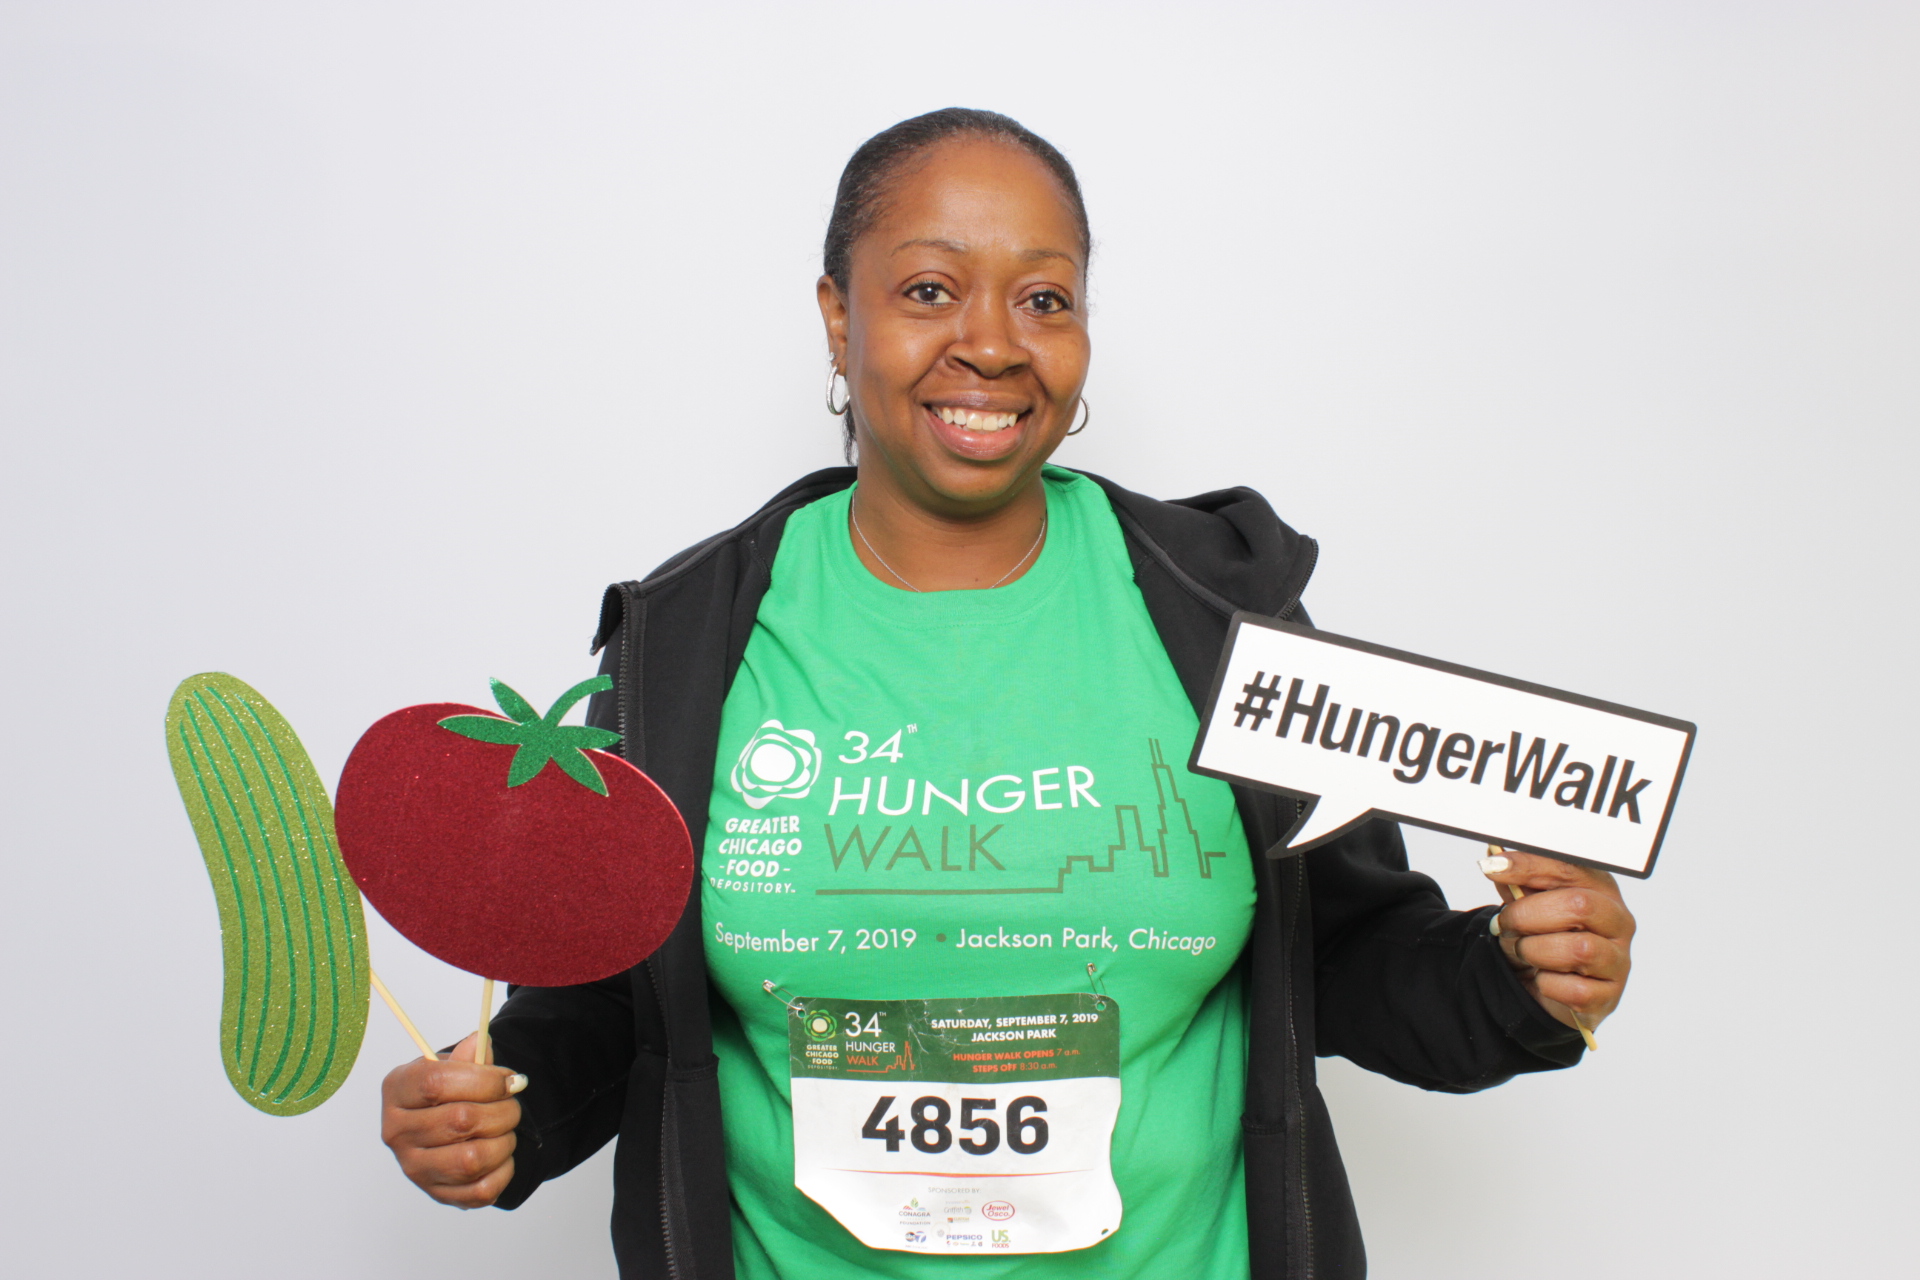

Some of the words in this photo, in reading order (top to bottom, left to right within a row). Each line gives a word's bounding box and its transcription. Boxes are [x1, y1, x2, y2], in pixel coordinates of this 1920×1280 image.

[1233, 670, 1653, 825] #HungerWalk
[828, 765, 1102, 817] HUNGER
[725, 815, 800, 834] GREATER
[718, 838, 803, 856] CHICAGO
[823, 823, 1007, 873] WALK
[715, 922, 819, 954] September
[827, 929, 847, 955] 7,
[855, 928, 917, 950] 2019
[956, 926, 1052, 949] Jackson
[1062, 926, 1119, 953] Park,
[1129, 927, 1217, 956] Chicago
[931, 1018, 993, 1030] SATURDAY,
[995, 1014, 1058, 1028] SEPTEMBER
[1059, 1013, 1070, 1026] 7,
[1072, 1013, 1099, 1024] 2019
[971, 1029, 1025, 1043] JACKSON
[1027, 1028, 1057, 1040] PARK
[805, 1051, 839, 1059] CHICAGO
[806, 1044, 838, 1052] GREATER
[845, 1041, 896, 1054] HUNGER
[953, 1051, 993, 1062] HUNGER
[994, 1051, 1022, 1061] WALK
[1023, 1049, 1055, 1060] OPENS
[1056, 1047, 1063, 1057] 7
[1064, 1047, 1081, 1057] a.m.
[846, 1055, 879, 1067] WALK
[972, 1064, 999, 1074] STEPS
[1000, 1063, 1018, 1073] OFF
[1019, 1062, 1040, 1072] 8:30
[1041, 1061, 1058, 1071] a.m.
[861, 1095, 1050, 1156] 4856
[928, 1187, 970, 1195] SPONSORED
[898, 1210, 932, 1218] CONAGRA
[986, 1203, 1010, 1212] Jewel
[987, 1210, 1010, 1218] Osco
